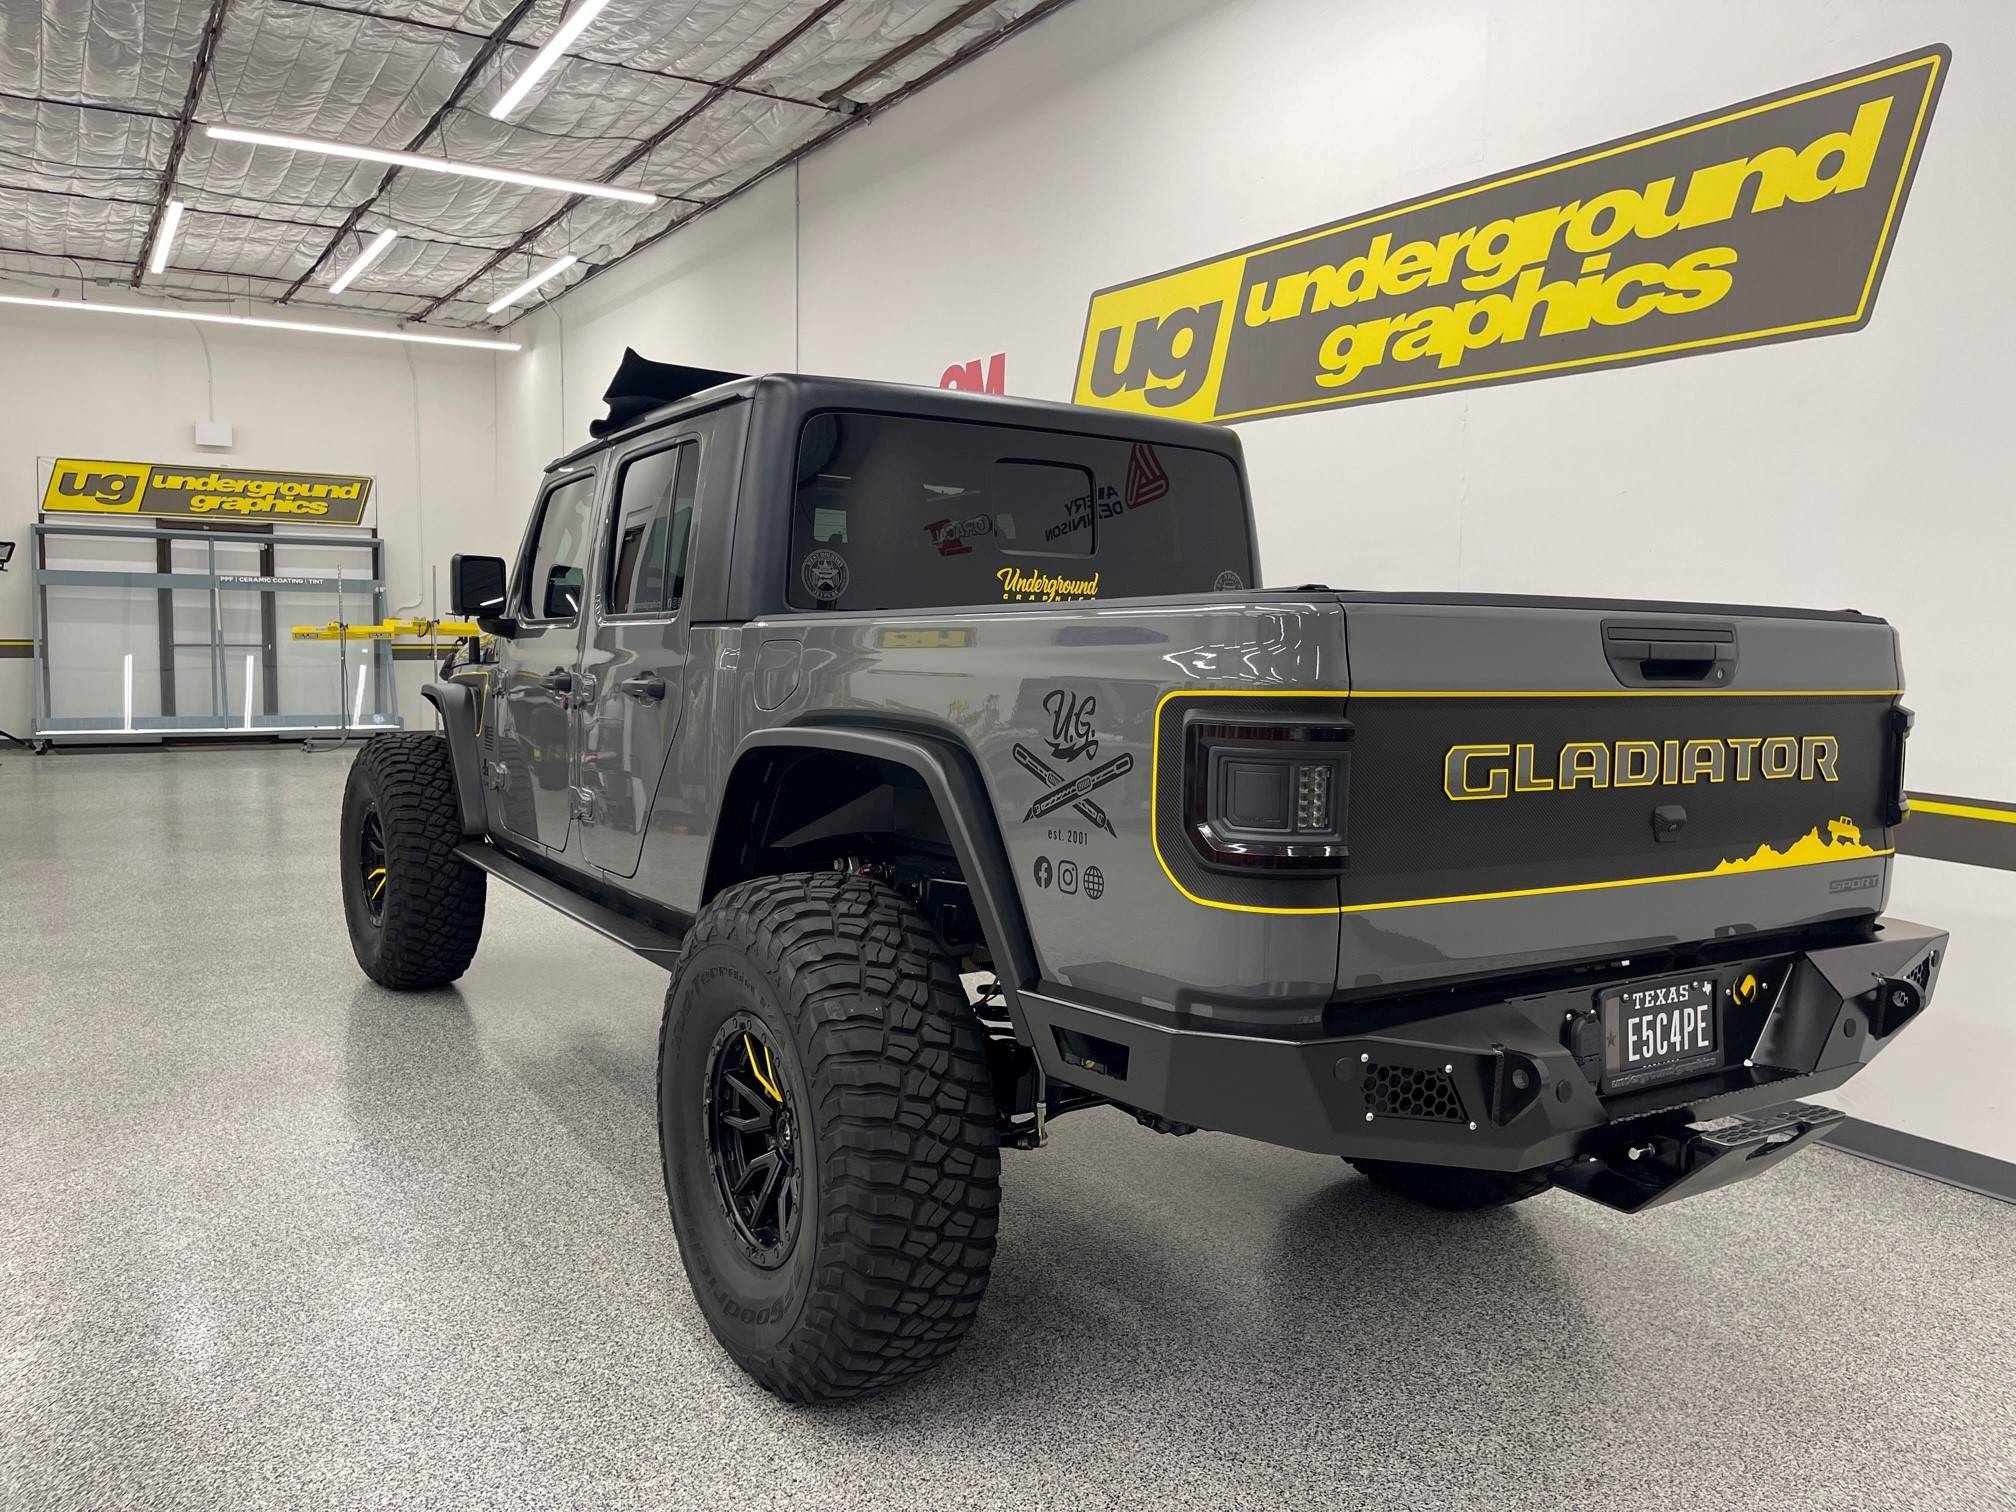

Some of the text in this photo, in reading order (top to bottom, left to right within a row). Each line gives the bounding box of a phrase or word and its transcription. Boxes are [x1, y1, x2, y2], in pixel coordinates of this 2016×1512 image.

[1243, 96, 1895, 327] underground
[1315, 247, 1738, 389] graphics
[1090, 298, 1223, 405] ug
[58, 472, 139, 504] ug
[151, 473, 362, 500] underground
[189, 493, 329, 516] graphics
[238, 576, 272, 584] CERAMIC
[272, 576, 304, 585] COATING
[996, 567, 1100, 602] Underground
[1444, 736, 1839, 801] GLADIATOR
[1047, 829, 1088, 846] est. 2001
[1632, 984, 1690, 1010] TEXAS
[1628, 1004, 1709, 1062] E5C4PE
